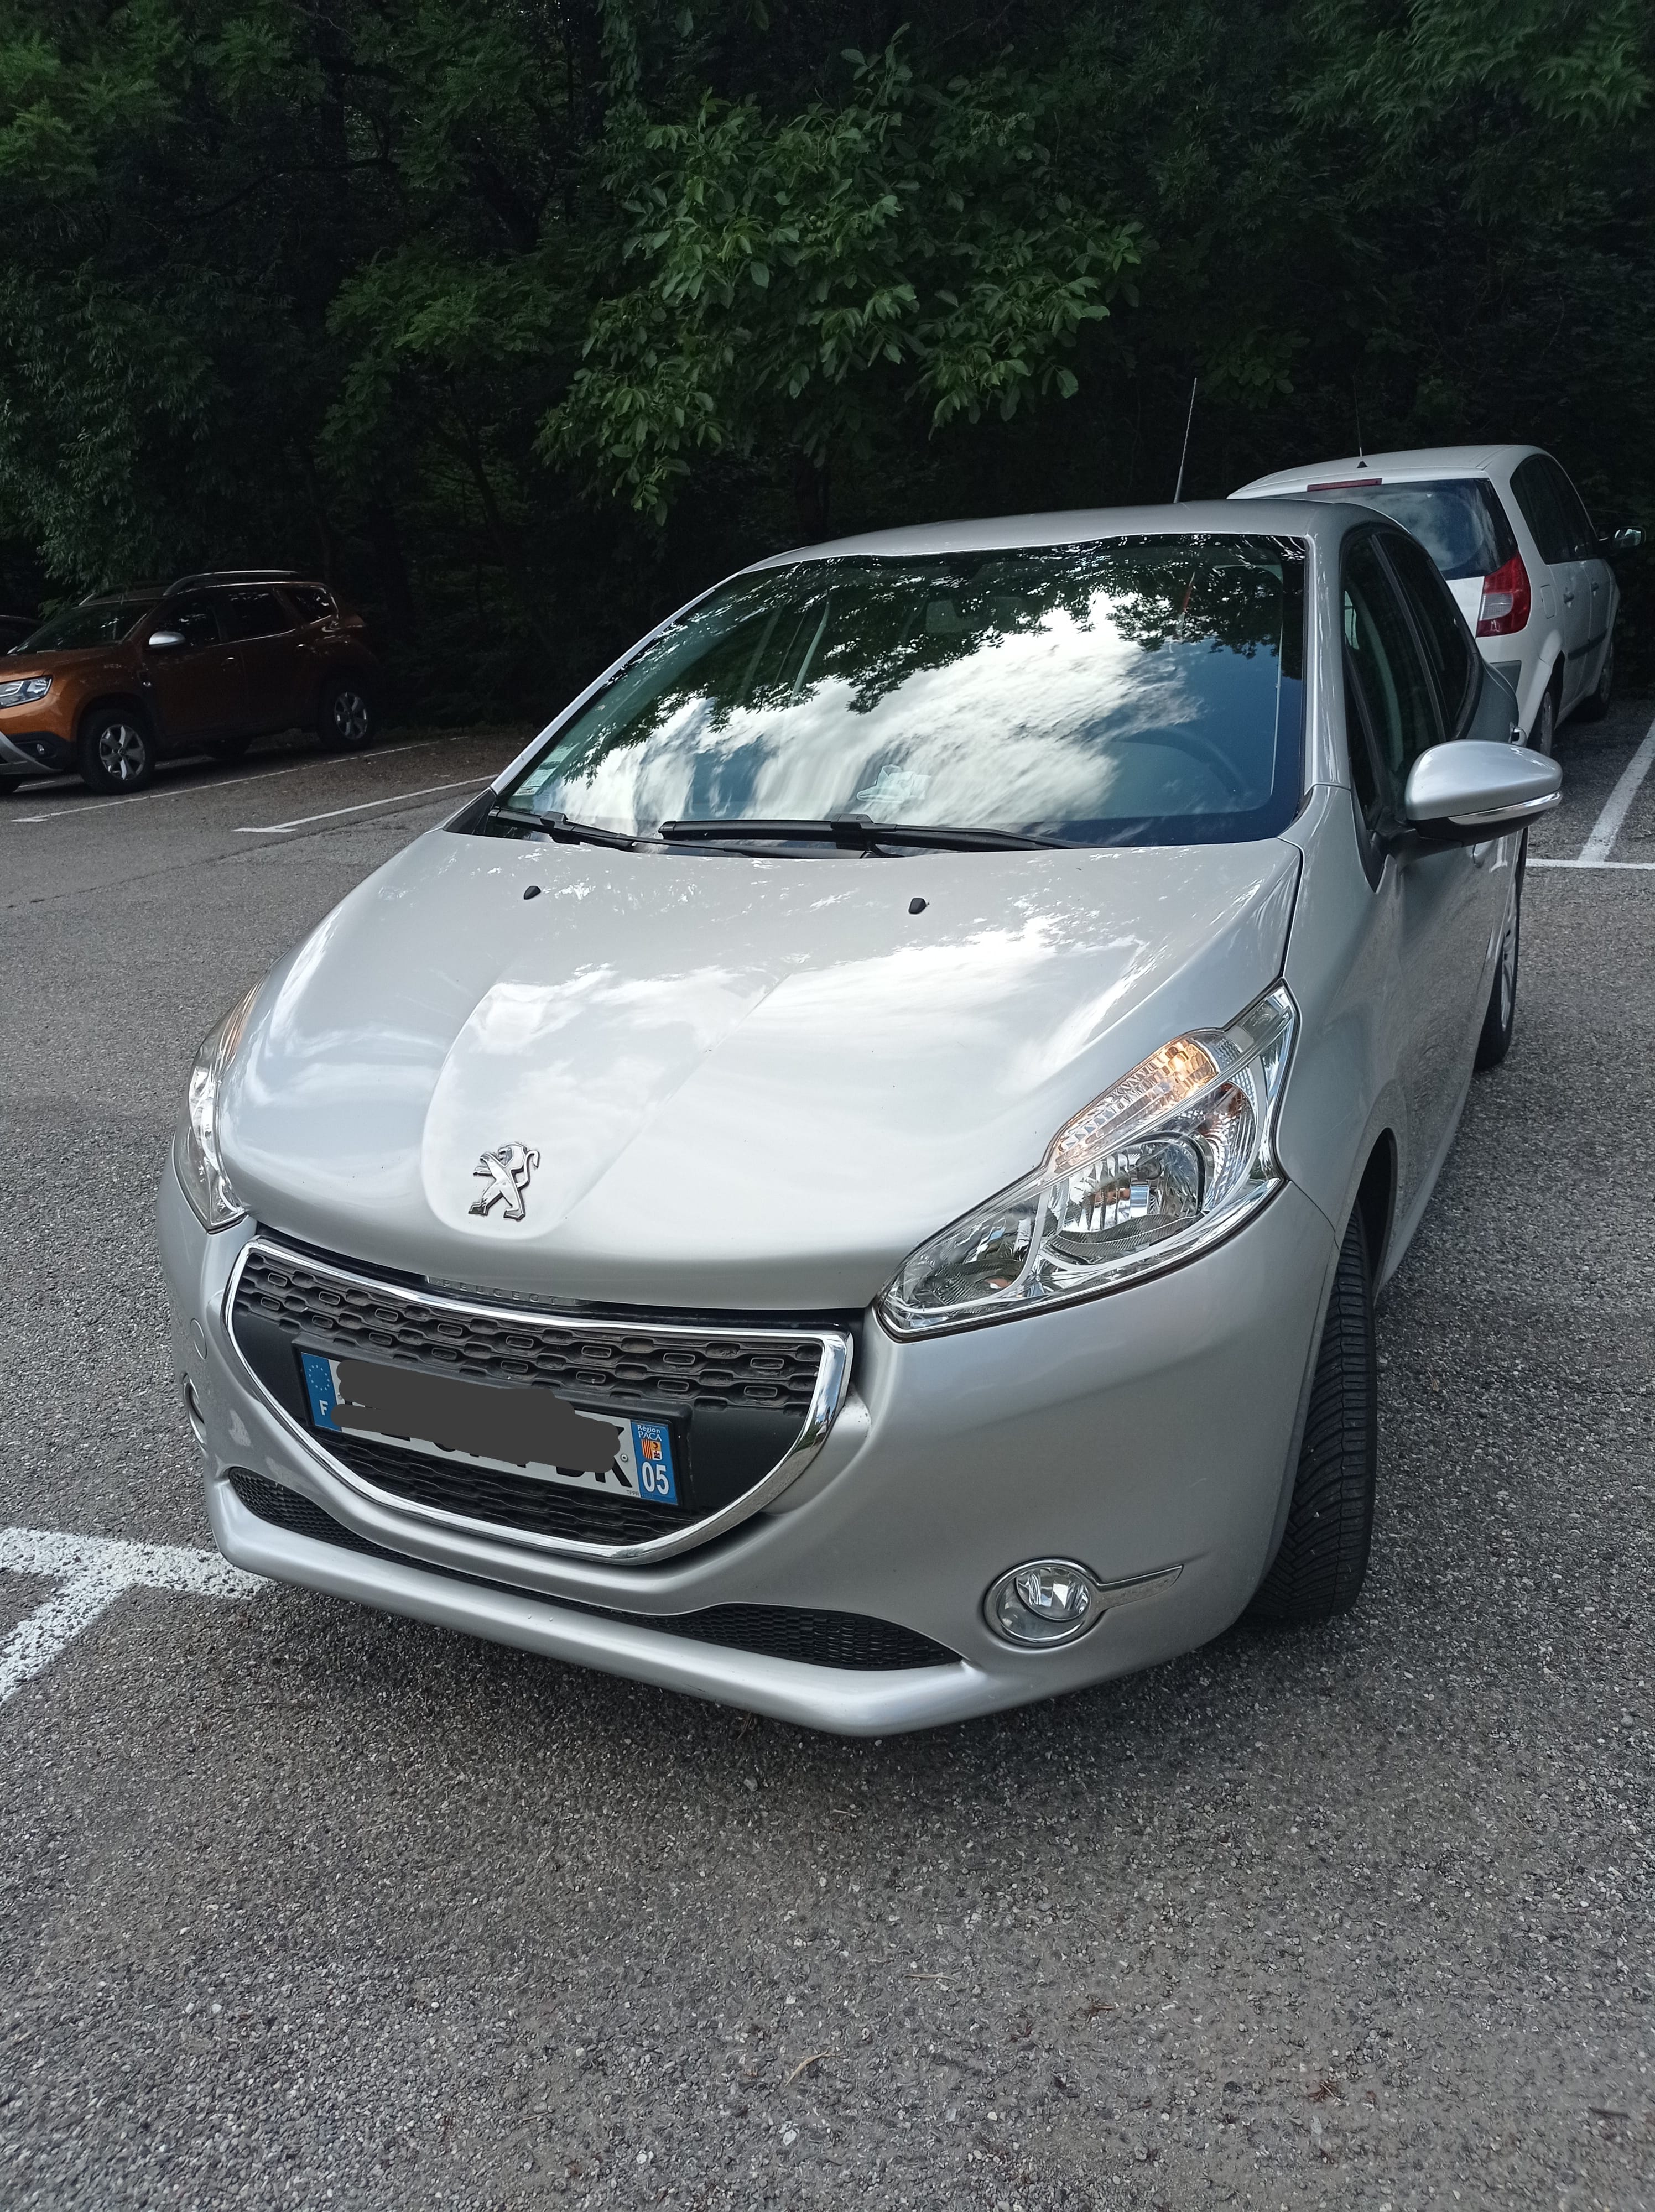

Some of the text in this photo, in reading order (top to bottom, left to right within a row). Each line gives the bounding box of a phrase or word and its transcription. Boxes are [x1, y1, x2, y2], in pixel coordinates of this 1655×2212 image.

[443, 1279, 558, 1305] PEUGEOT
[319, 1399, 329, 1416] F
[637, 1424, 660, 1434] Région
[638, 1431, 662, 1442] PACA
[642, 1462, 669, 1495] 05
